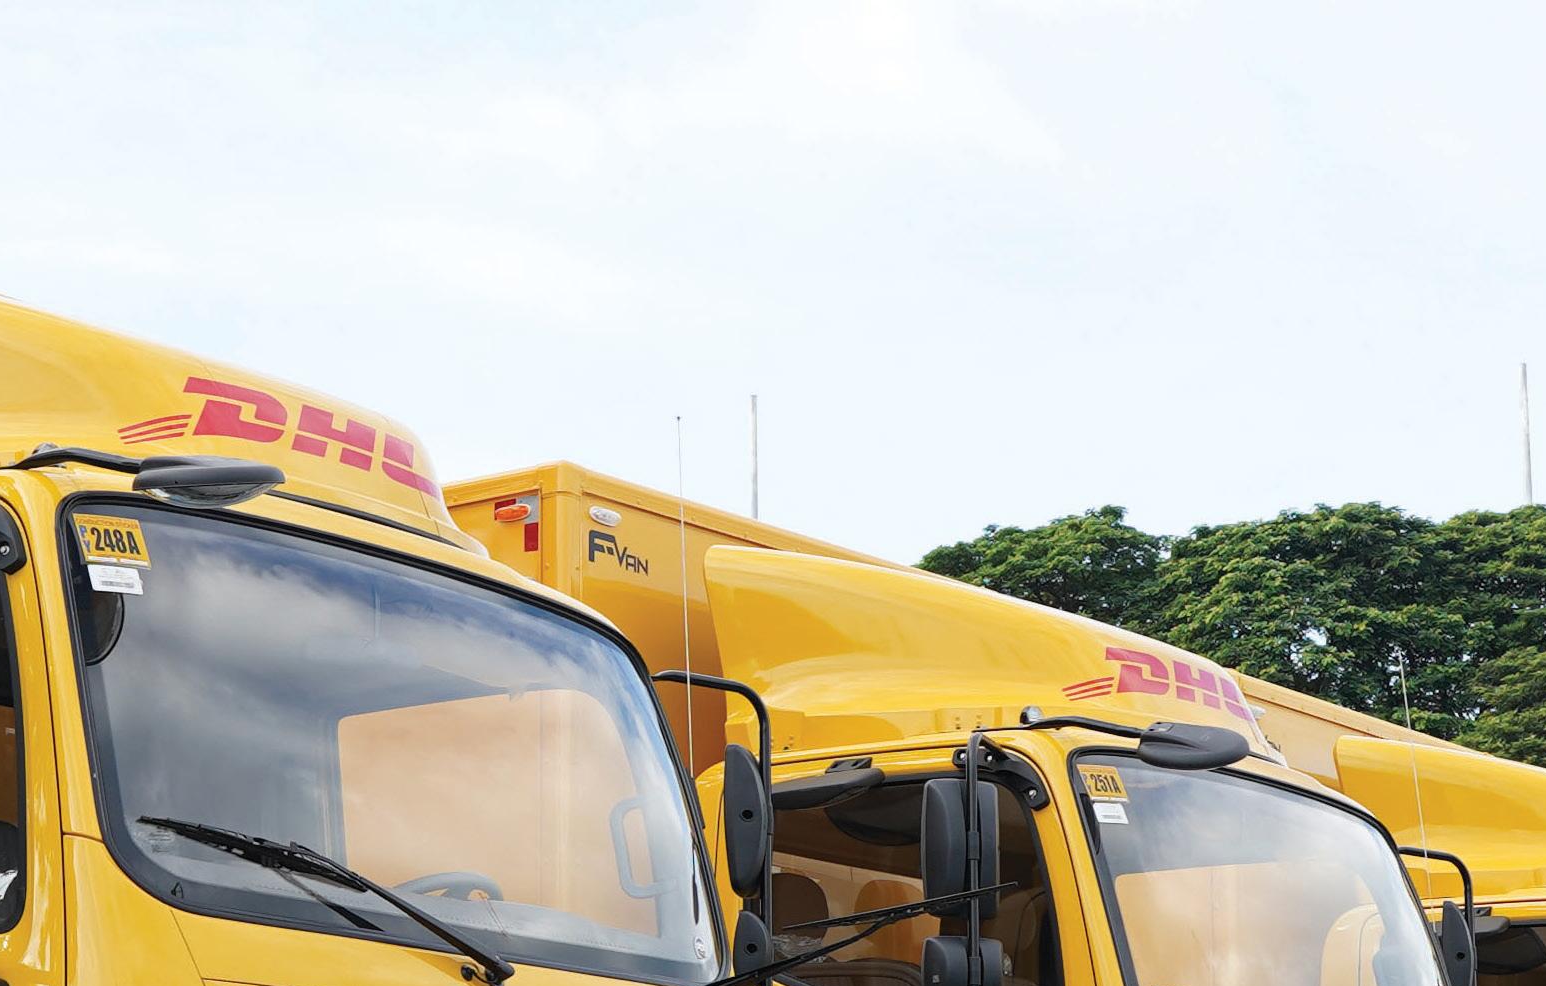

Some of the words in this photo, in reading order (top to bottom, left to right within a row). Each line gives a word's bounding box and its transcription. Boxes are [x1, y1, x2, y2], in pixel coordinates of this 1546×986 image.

[183, 376, 440, 498] DHL
[90, 527, 142, 555] 248A
[1105, 646, 1253, 722] DHL
[1089, 773, 1123, 794] 251A
